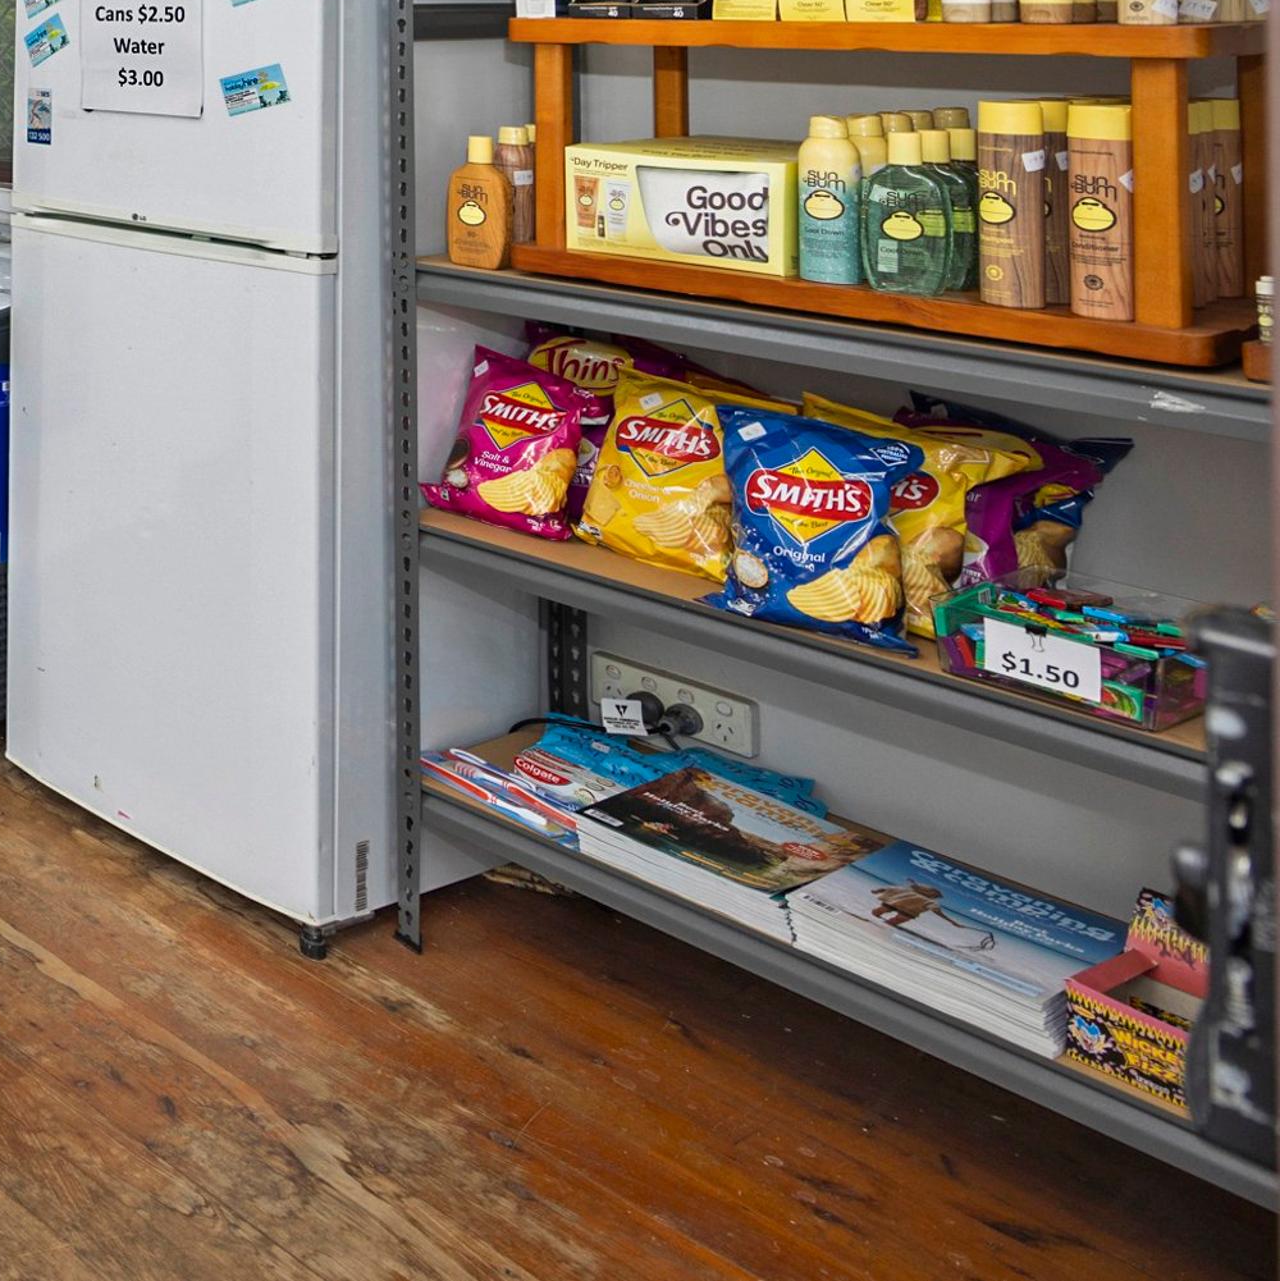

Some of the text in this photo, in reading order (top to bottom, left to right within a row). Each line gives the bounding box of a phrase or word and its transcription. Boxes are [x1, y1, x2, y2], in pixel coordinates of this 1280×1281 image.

[95, 5, 185, 25] Cans $2.50
[114, 38, 165, 55] Water
[118, 69, 164, 87] $3.00
[574, 158, 628, 171] Day Tripper
[686, 186, 769, 211] Good
[680, 213, 767, 238] Vibes
[535, 339, 625, 383] Thins
[480, 394, 560, 431] SMITH'S
[620, 420, 711, 456] SMITH'S
[475, 457, 512, 473] Vinegar
[482, 450, 510, 464] Salt &
[806, 466, 834, 478] Original
[628, 488, 660, 503] Onion
[752, 474, 865, 513] SMITH'S
[811, 521, 828, 529] Best
[773, 545, 825, 564] Original
[1001, 652, 1080, 690] $1.50
[515, 757, 561, 784] Colgate
[911, 850, 1055, 911] Caravan
[1112, 1029, 1186, 1065] WICKE
